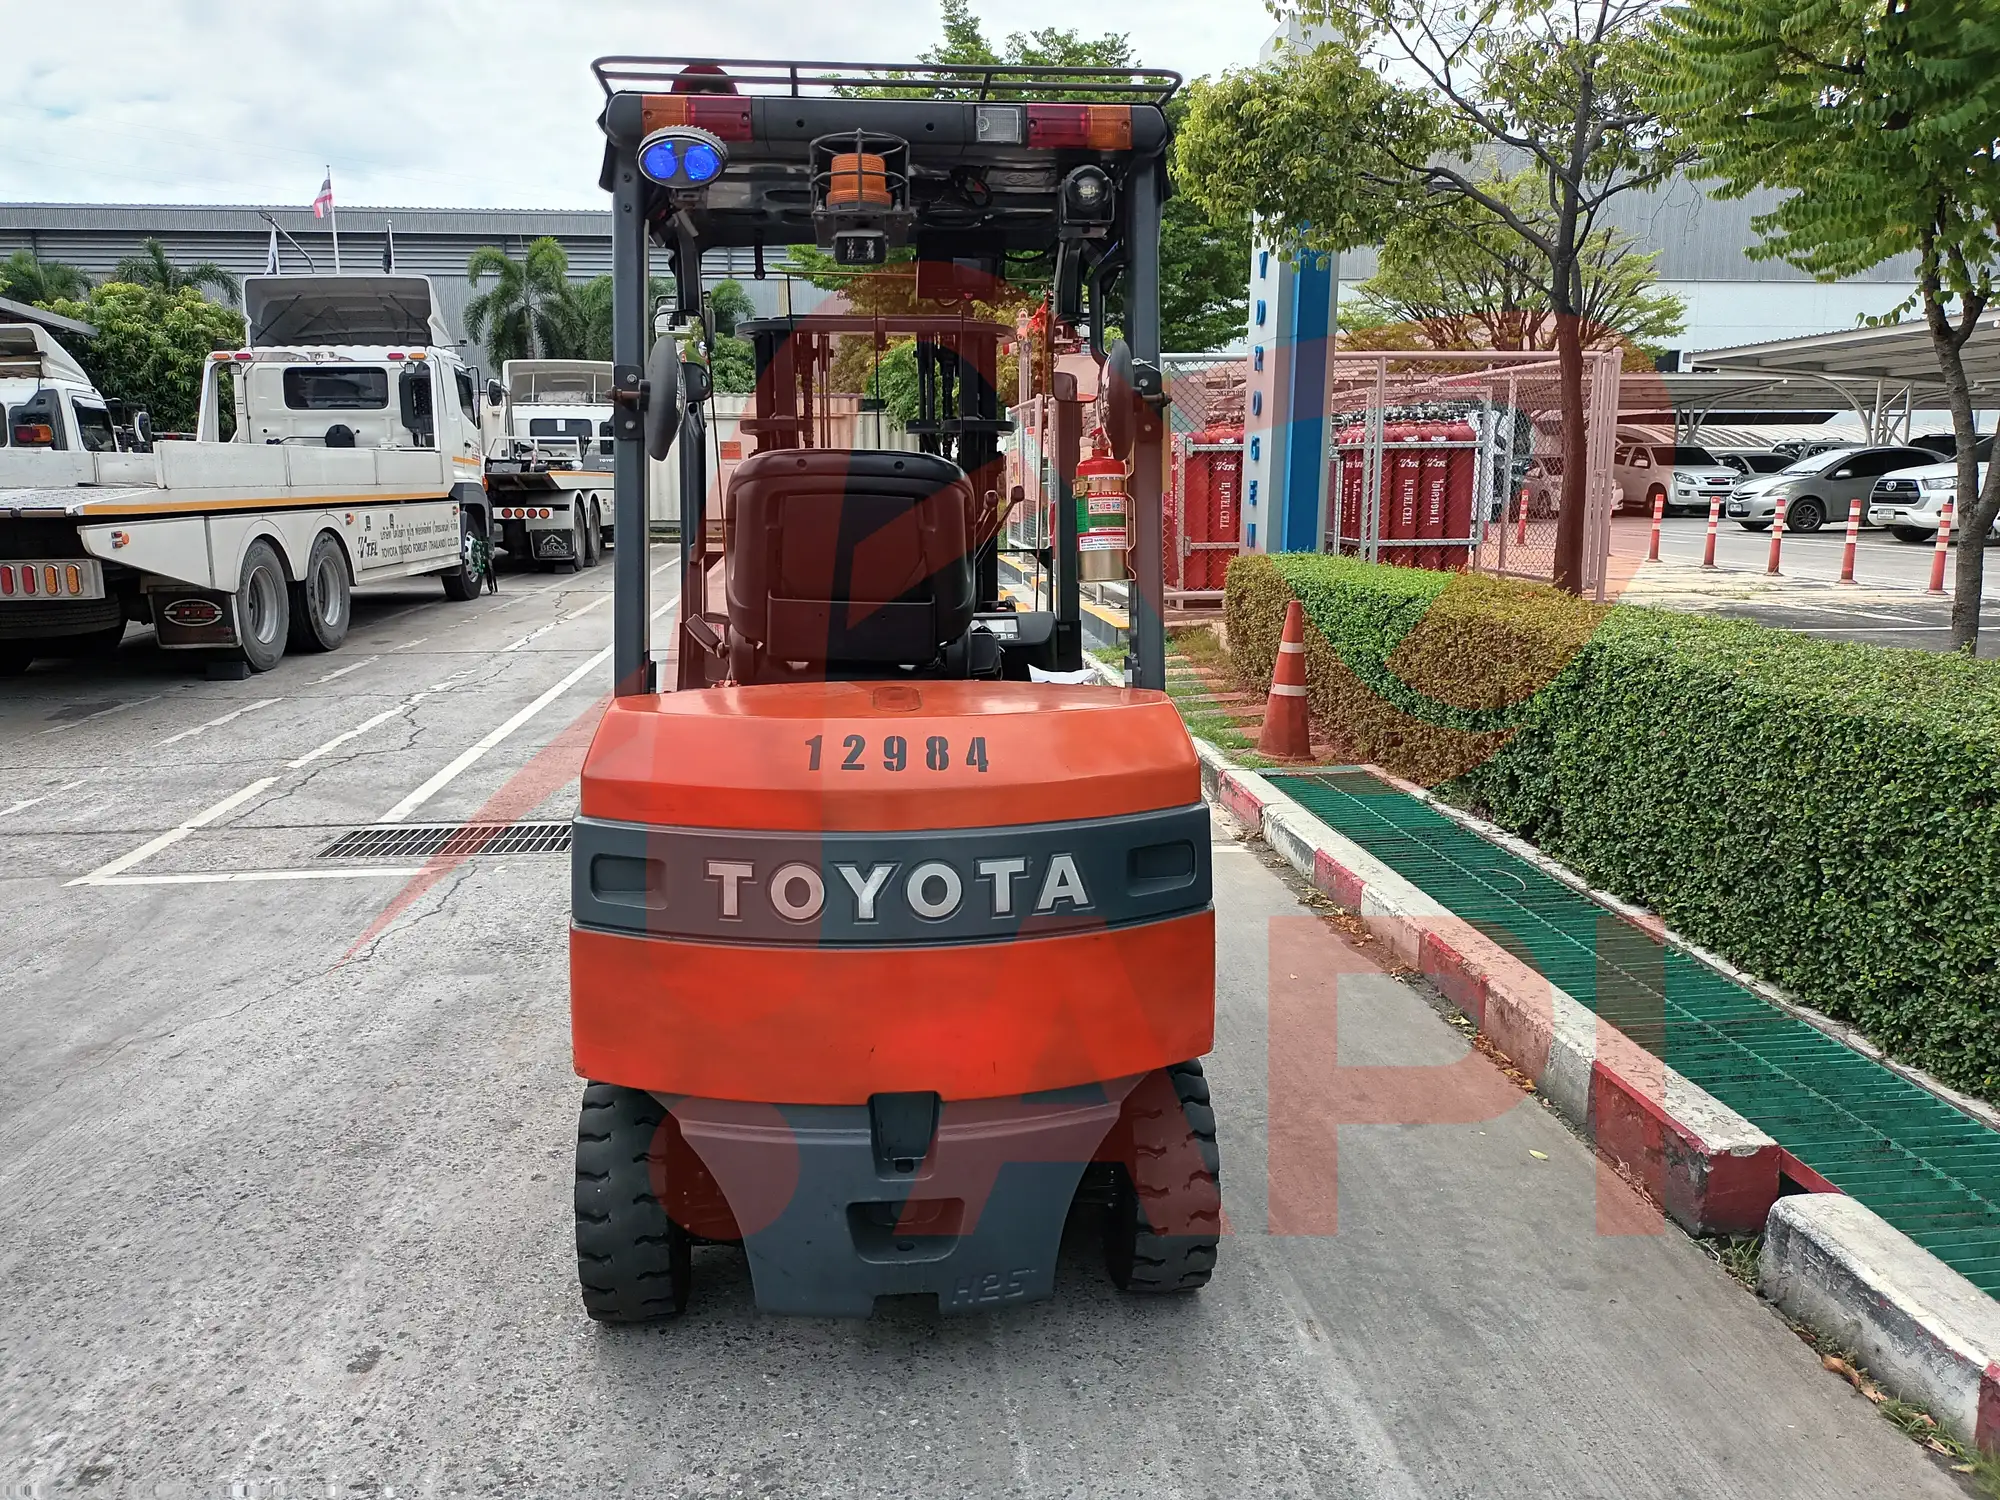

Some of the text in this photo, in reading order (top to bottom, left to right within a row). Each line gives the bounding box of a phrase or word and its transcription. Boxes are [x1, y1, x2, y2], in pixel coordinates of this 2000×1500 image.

[1220, 491, 1231, 510] FUEL
[1403, 488, 1414, 507] FUEL
[1219, 510, 1230, 530] CELL
[1402, 507, 1413, 526] CELL
[805, 735, 989, 772] 12984
[707, 855, 1089, 920] TOYOTA
